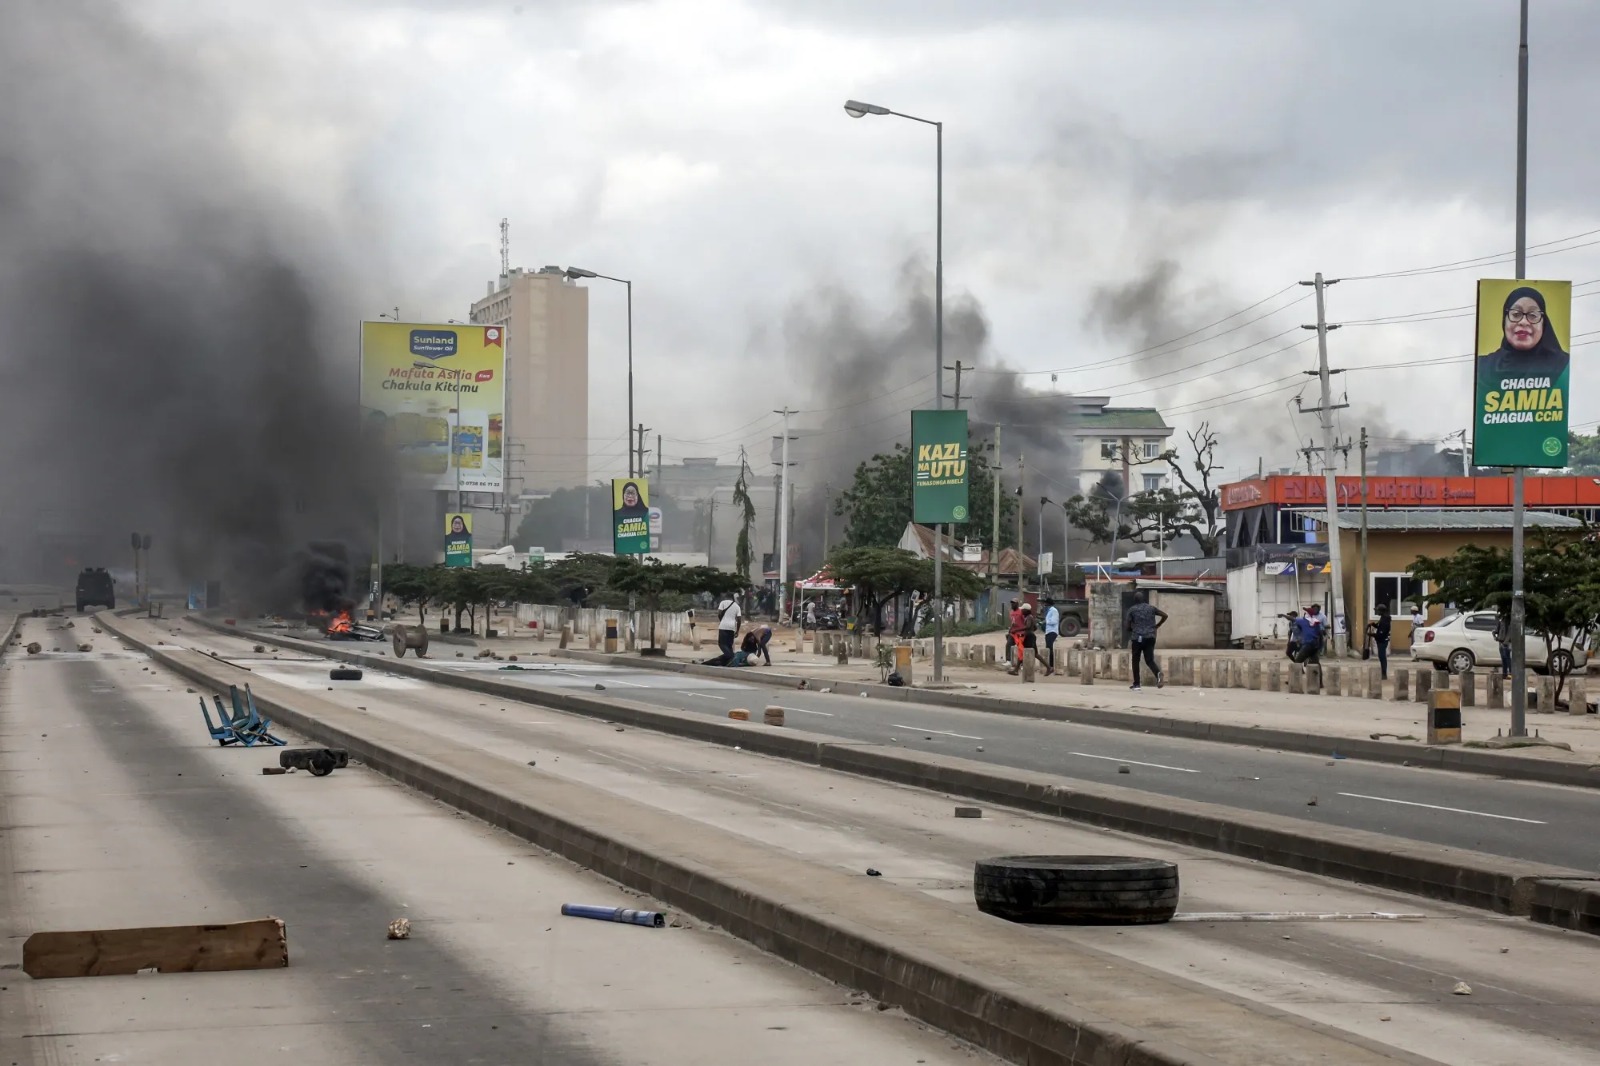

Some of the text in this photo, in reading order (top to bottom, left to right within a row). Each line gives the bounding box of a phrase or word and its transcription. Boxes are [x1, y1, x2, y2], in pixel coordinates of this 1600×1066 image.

[413, 336, 454, 344] Sunland
[389, 367, 434, 379] Mafuta
[382, 379, 478, 393] Chakula Kitamu
[1500, 377, 1551, 390] CHAGUA
[1484, 388, 1563, 412] SAMIA
[1483, 410, 1563, 424] CHAGUA CCM
[919, 442, 960, 461] KAZI
[918, 459, 966, 478] NA UTU
[617, 521, 647, 533] SAMIA
[447, 543, 470, 552] SAMIA
